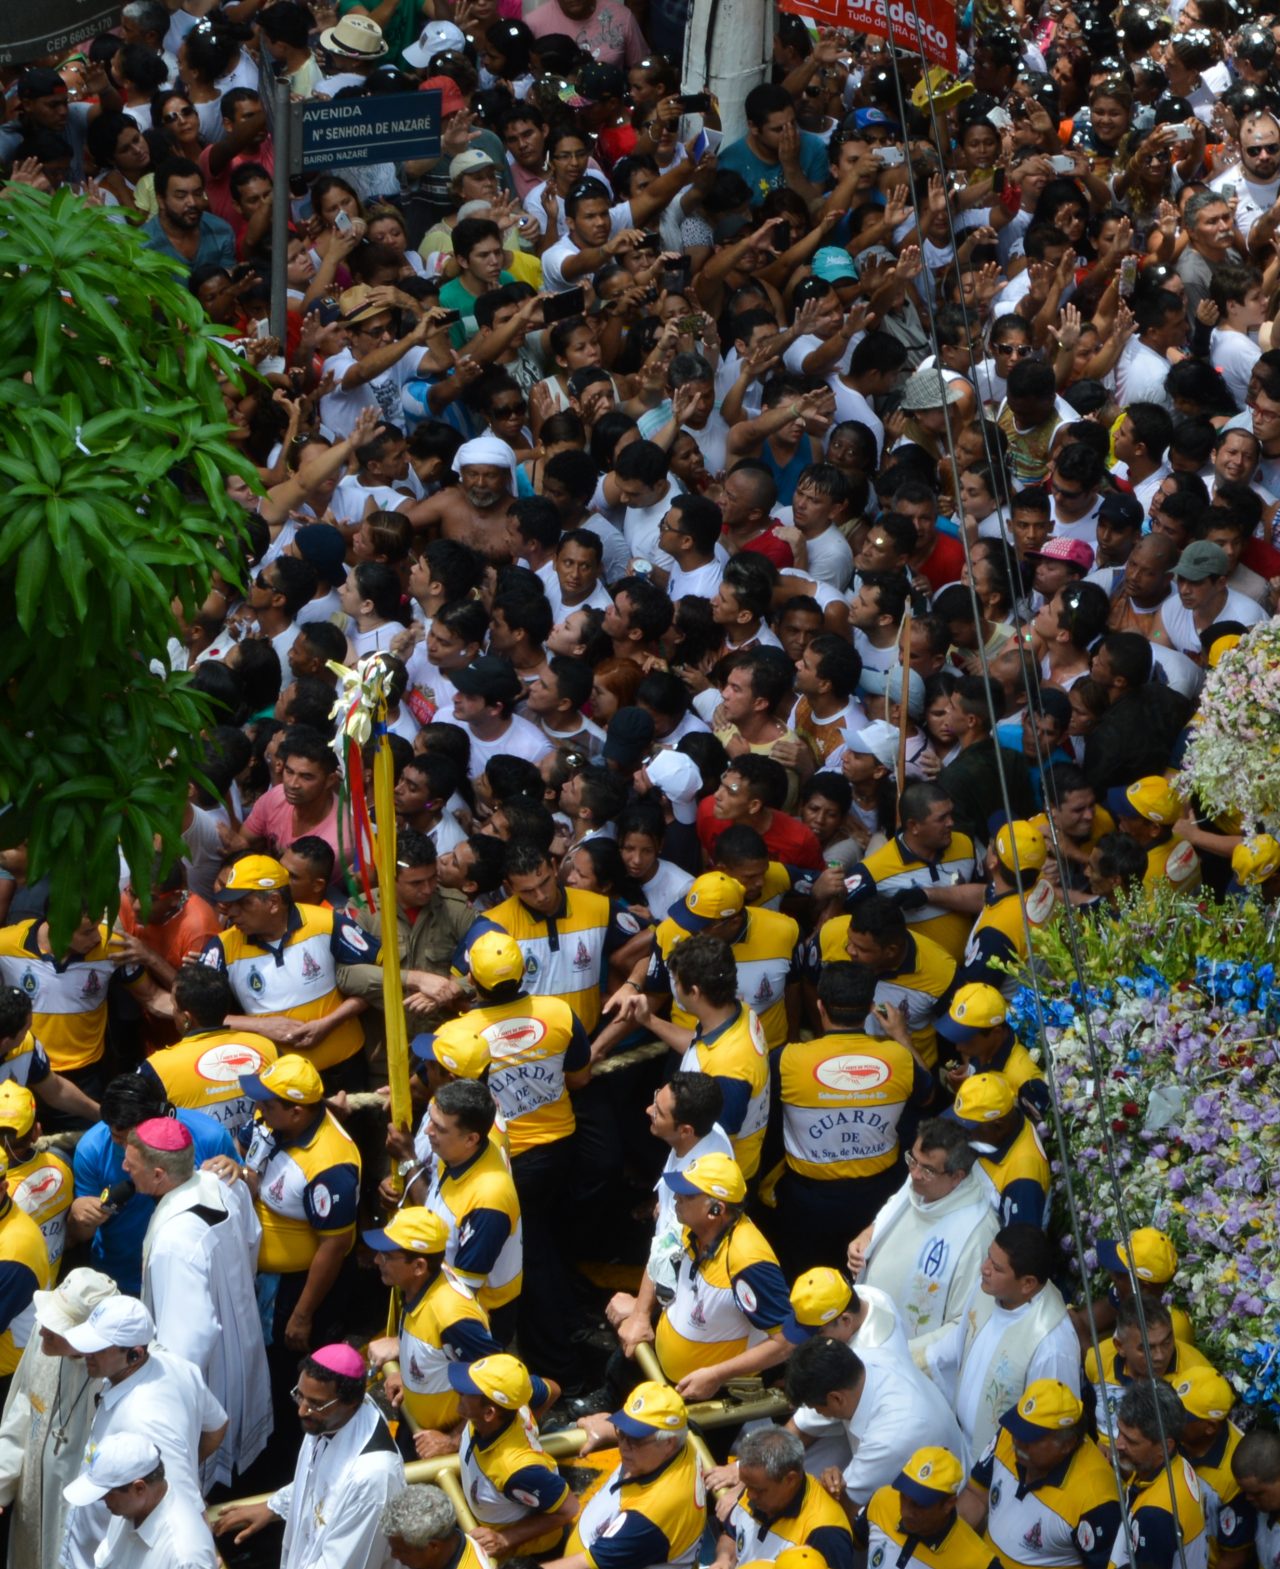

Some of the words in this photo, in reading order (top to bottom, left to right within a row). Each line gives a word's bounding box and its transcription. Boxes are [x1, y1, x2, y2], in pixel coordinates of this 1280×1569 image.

[847, 9, 873, 24] Tudo
[46, 35, 67, 52] CEP
[69, 17, 113, 44] 66035-170
[303, 105, 362, 122] AVENIDA
[325, 123, 373, 140] SENHORA
[375, 121, 389, 134] DE
[391, 115, 432, 133] NAZARÉ
[303, 153, 334, 165] BAIRRO
[335, 148, 368, 161] NAZARÉ
[490, 1066, 554, 1092] UARDA
[515, 1085, 529, 1101] DE
[808, 1110, 890, 1139] GUARDA
[841, 1131, 860, 1143] DE
[840, 1147, 850, 1157] de
